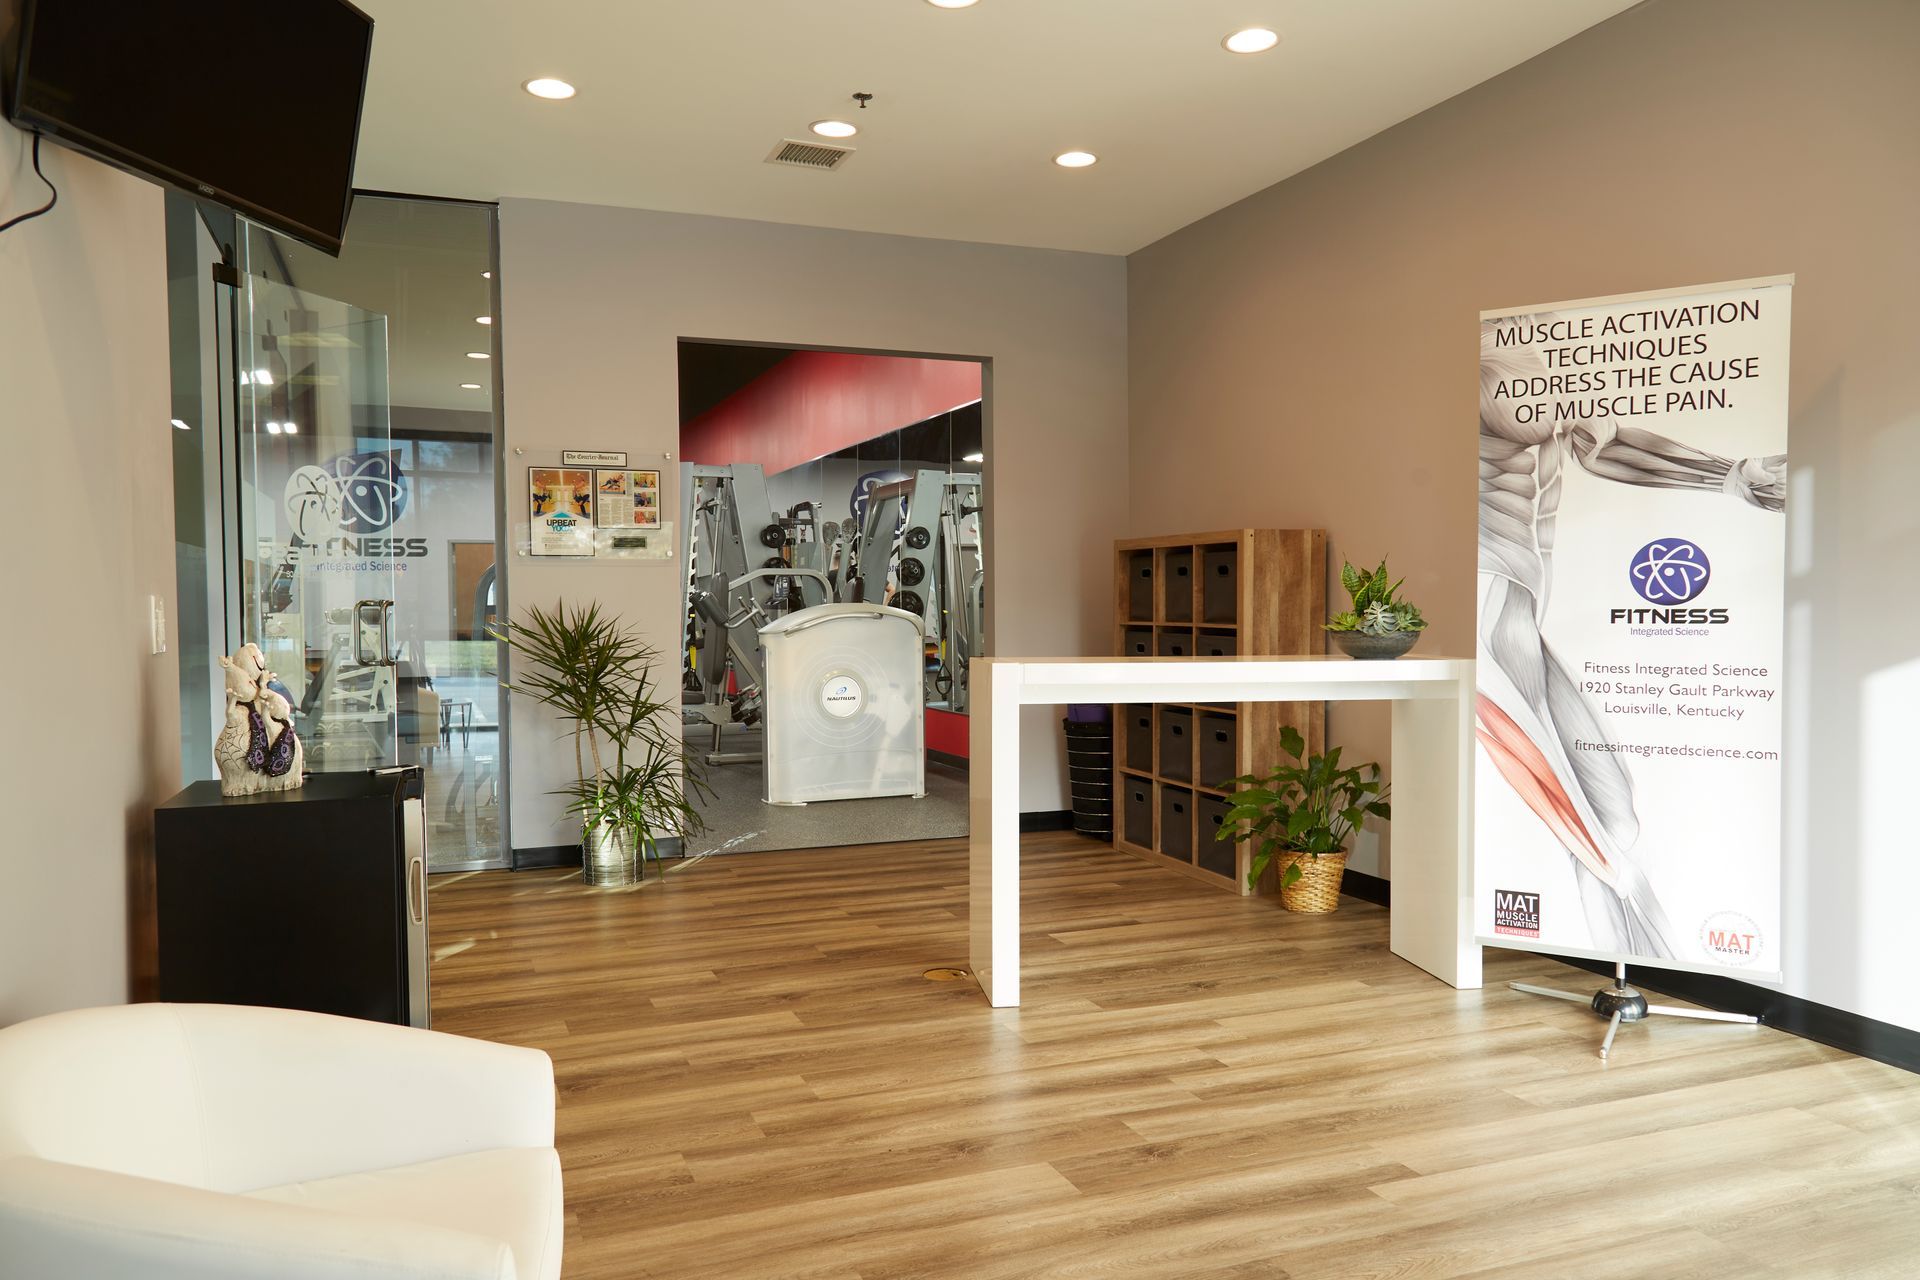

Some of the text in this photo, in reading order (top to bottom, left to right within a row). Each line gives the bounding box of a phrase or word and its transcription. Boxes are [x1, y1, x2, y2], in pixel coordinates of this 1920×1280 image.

[1495, 299, 1760, 347] MUSCLE ACTIVATION
[1543, 333, 1707, 368] TECHNIQUES
[1494, 357, 1760, 399] ADDRESS THE CAUSE
[1515, 388, 1733, 424] OF MUSCLE PAIN.
[546, 519, 577, 527] UPBEAT
[370, 560, 407, 571] Science
[1611, 608, 1730, 625] FITNESS
[1630, 627, 1709, 637] Integrated Science
[1584, 661, 1768, 678] Fitness Integrated Science
[1579, 681, 1775, 701] 1920 Stanley Gault Parkway
[1604, 702, 1744, 720] Louisville, Kentucky
[1575, 739, 1778, 760] fitnessintegratedscience.com
[1496, 892, 1538, 913] MAT
[1496, 910, 1538, 923] MUSCLE
[1496, 919, 1538, 929] ACTIVATION
[1709, 930, 1755, 951] MAT
[1715, 946, 1750, 956] MASTER
